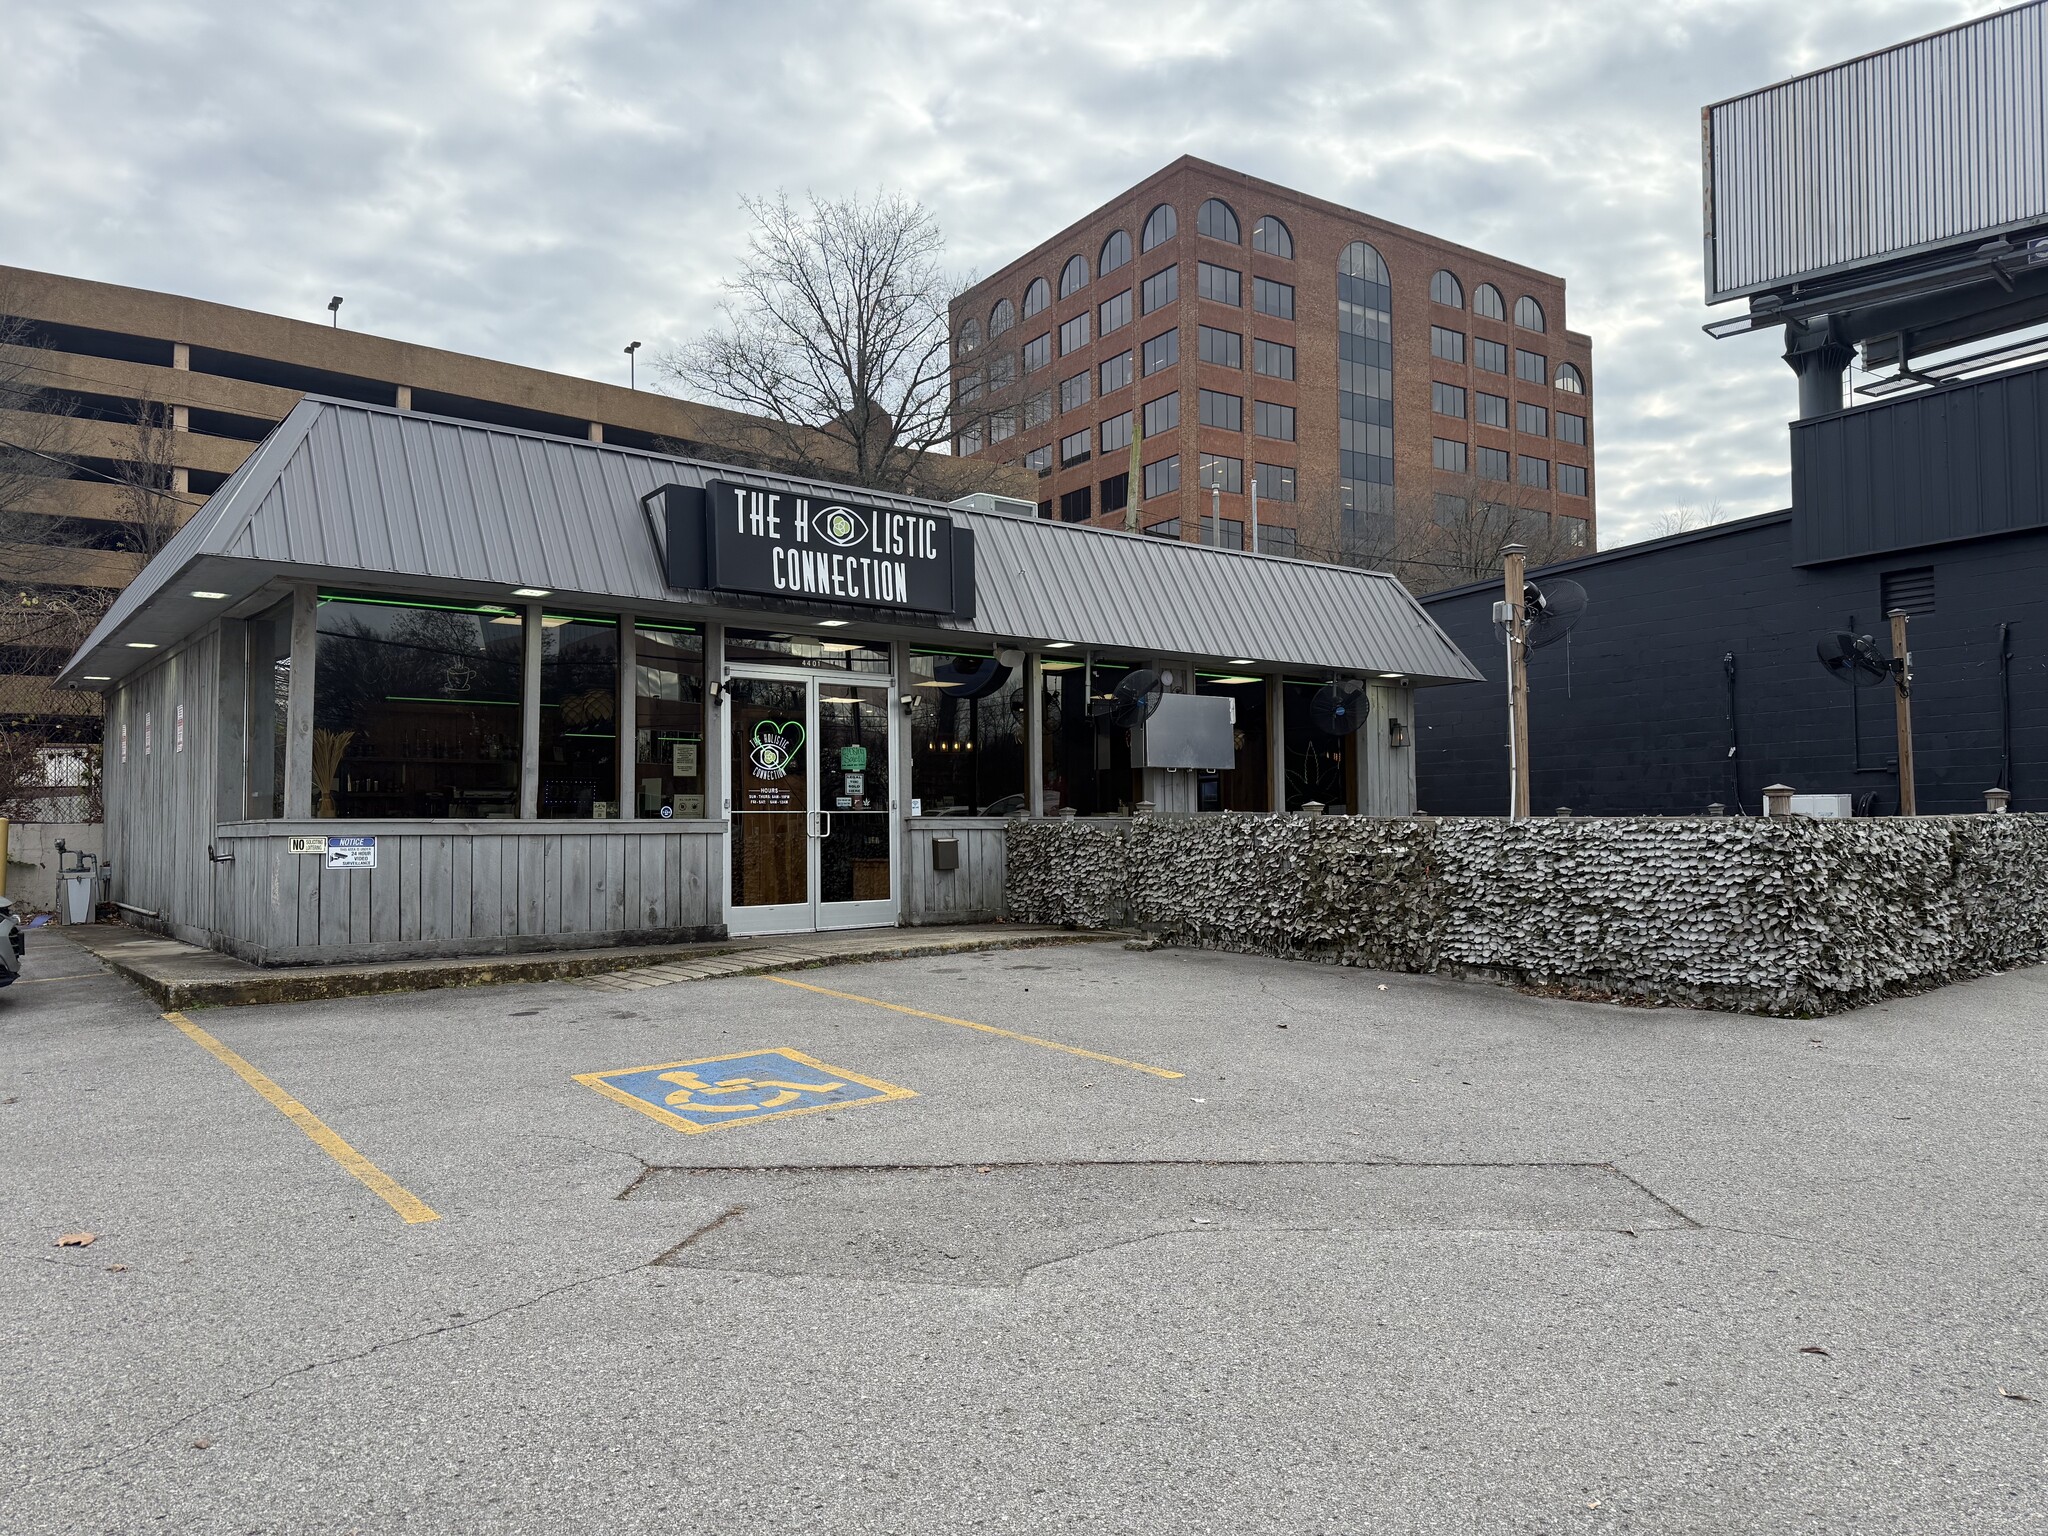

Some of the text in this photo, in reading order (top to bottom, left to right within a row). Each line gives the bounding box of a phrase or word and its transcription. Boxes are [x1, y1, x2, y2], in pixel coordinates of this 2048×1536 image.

[734, 488, 781, 539] THE
[772, 546, 908, 603] CONNECTION
[801, 659, 821, 667] 4401
[763, 733, 789, 749] HOLISTIC
[752, 767, 787, 780] CONNECTION
[292, 839, 305, 851] NO
[339, 838, 364, 846] NOTICE
